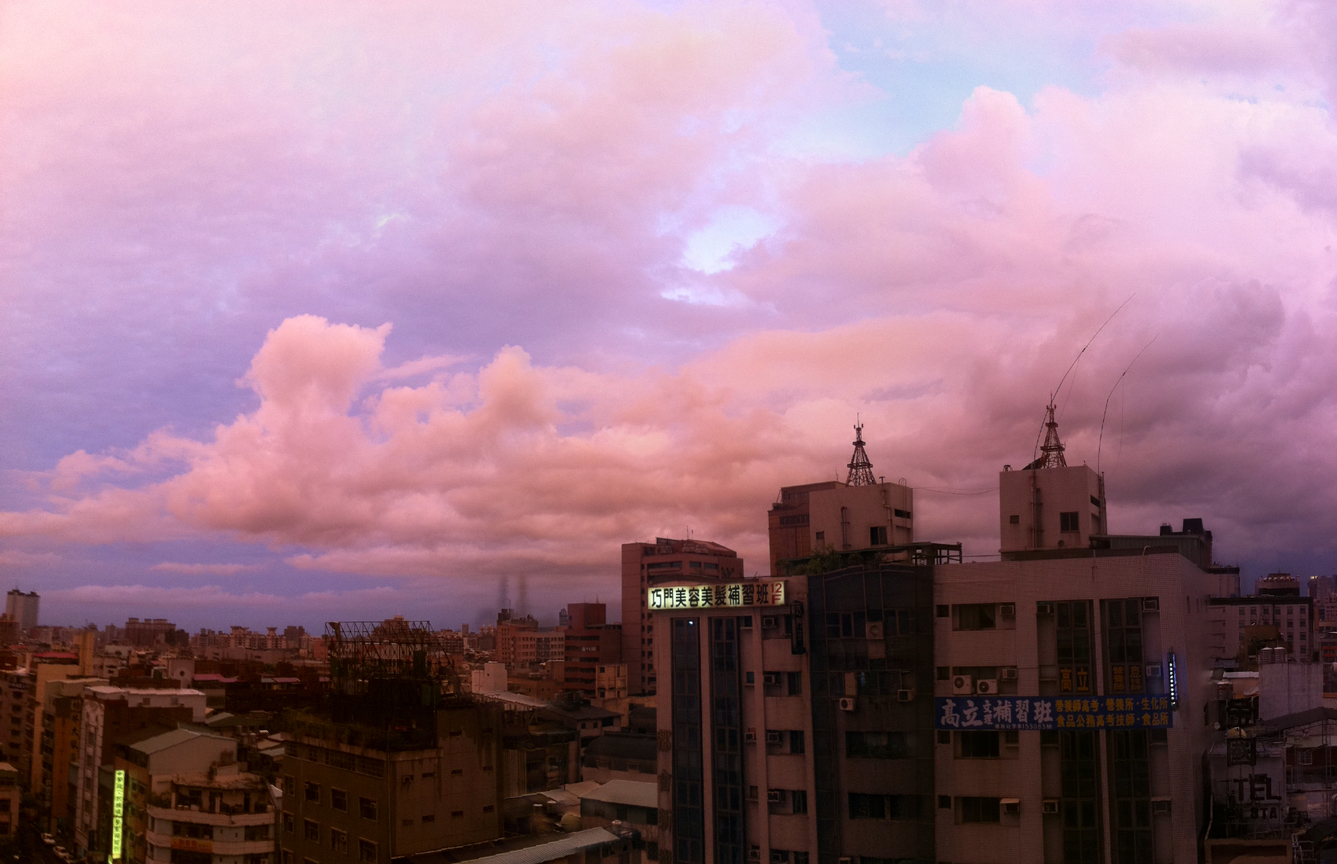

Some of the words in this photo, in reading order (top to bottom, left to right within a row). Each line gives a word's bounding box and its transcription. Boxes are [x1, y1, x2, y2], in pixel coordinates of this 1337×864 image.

[651, 583, 769, 608] 巧門美容美髮補習班
[1060, 667, 1088, 692] 高立
